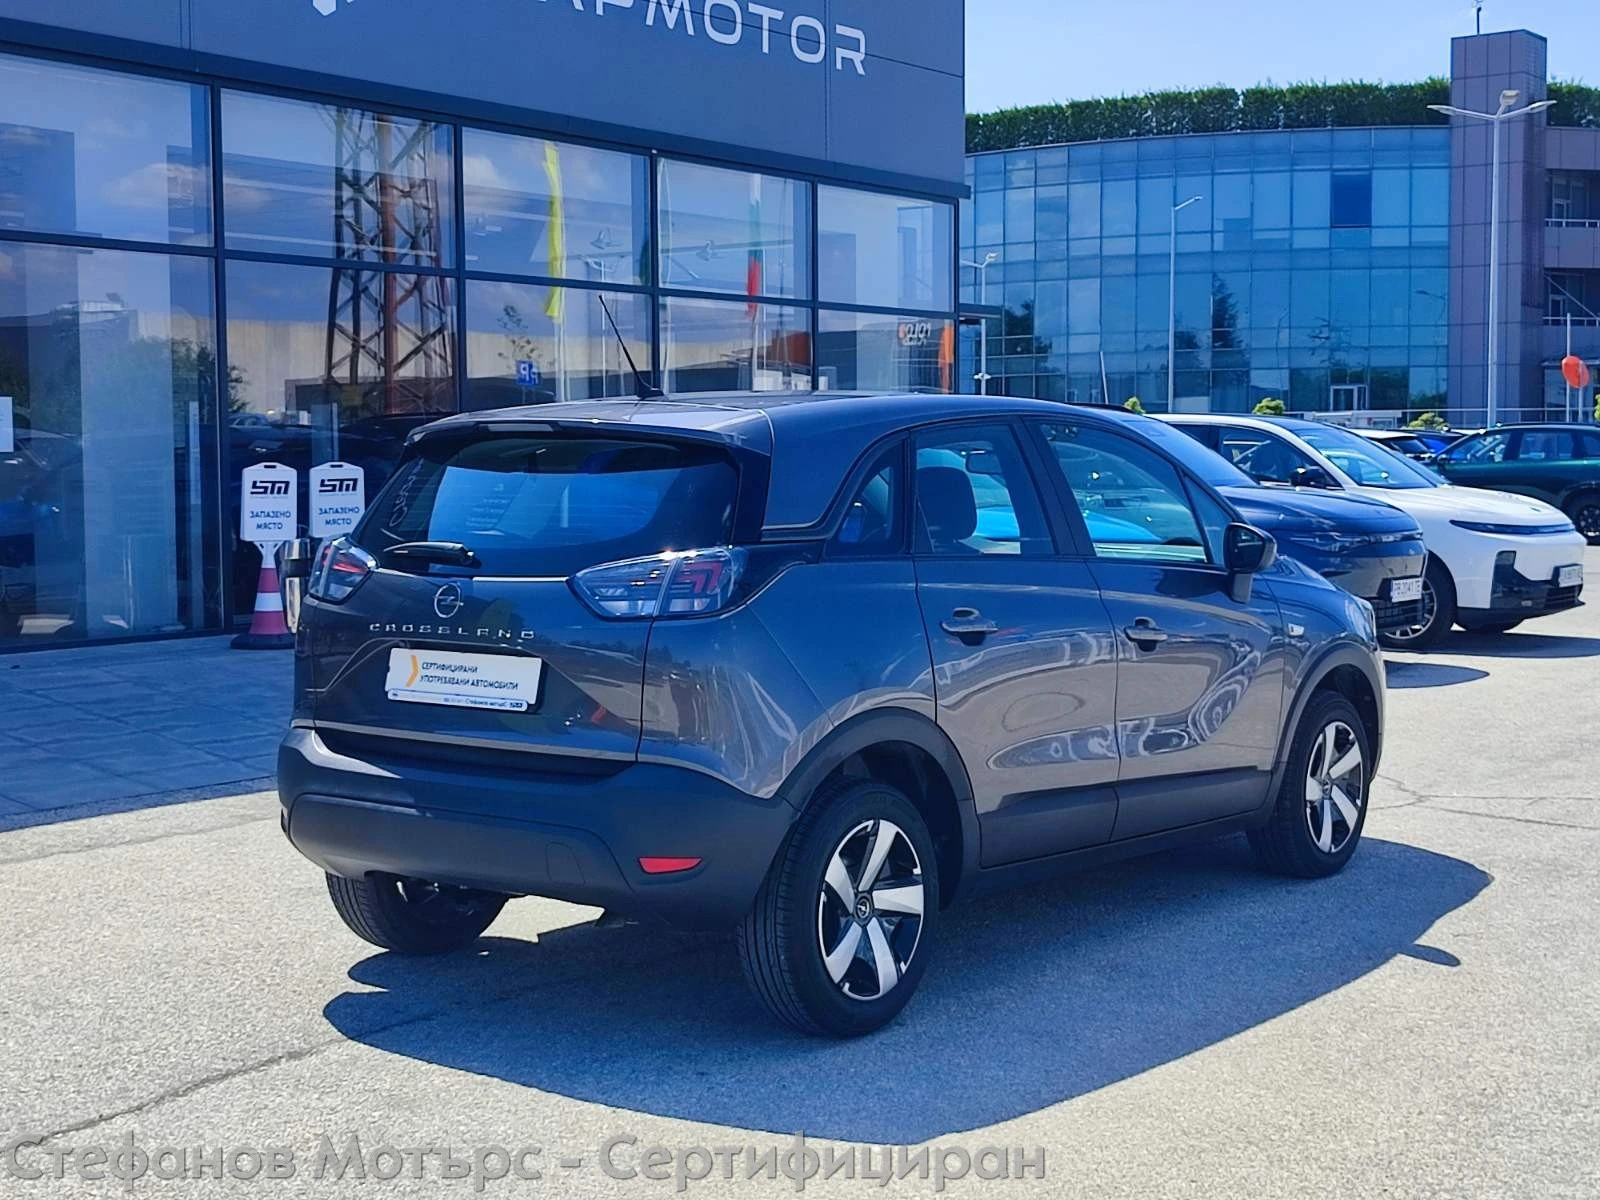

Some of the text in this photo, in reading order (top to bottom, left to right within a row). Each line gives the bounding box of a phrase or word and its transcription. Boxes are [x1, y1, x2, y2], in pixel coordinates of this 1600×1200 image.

[250, 510, 291, 518] ЗАПАЗЕНО
[319, 507, 360, 515] ЗАПАЗЕНО
[256, 522, 283, 530] МЯСТО
[325, 518, 352, 526] МЯСТО
[421, 661, 478, 674] СЕРТИФИЦИРАНИ
[470, 678, 519, 690] АВТОМОБИЛИ
